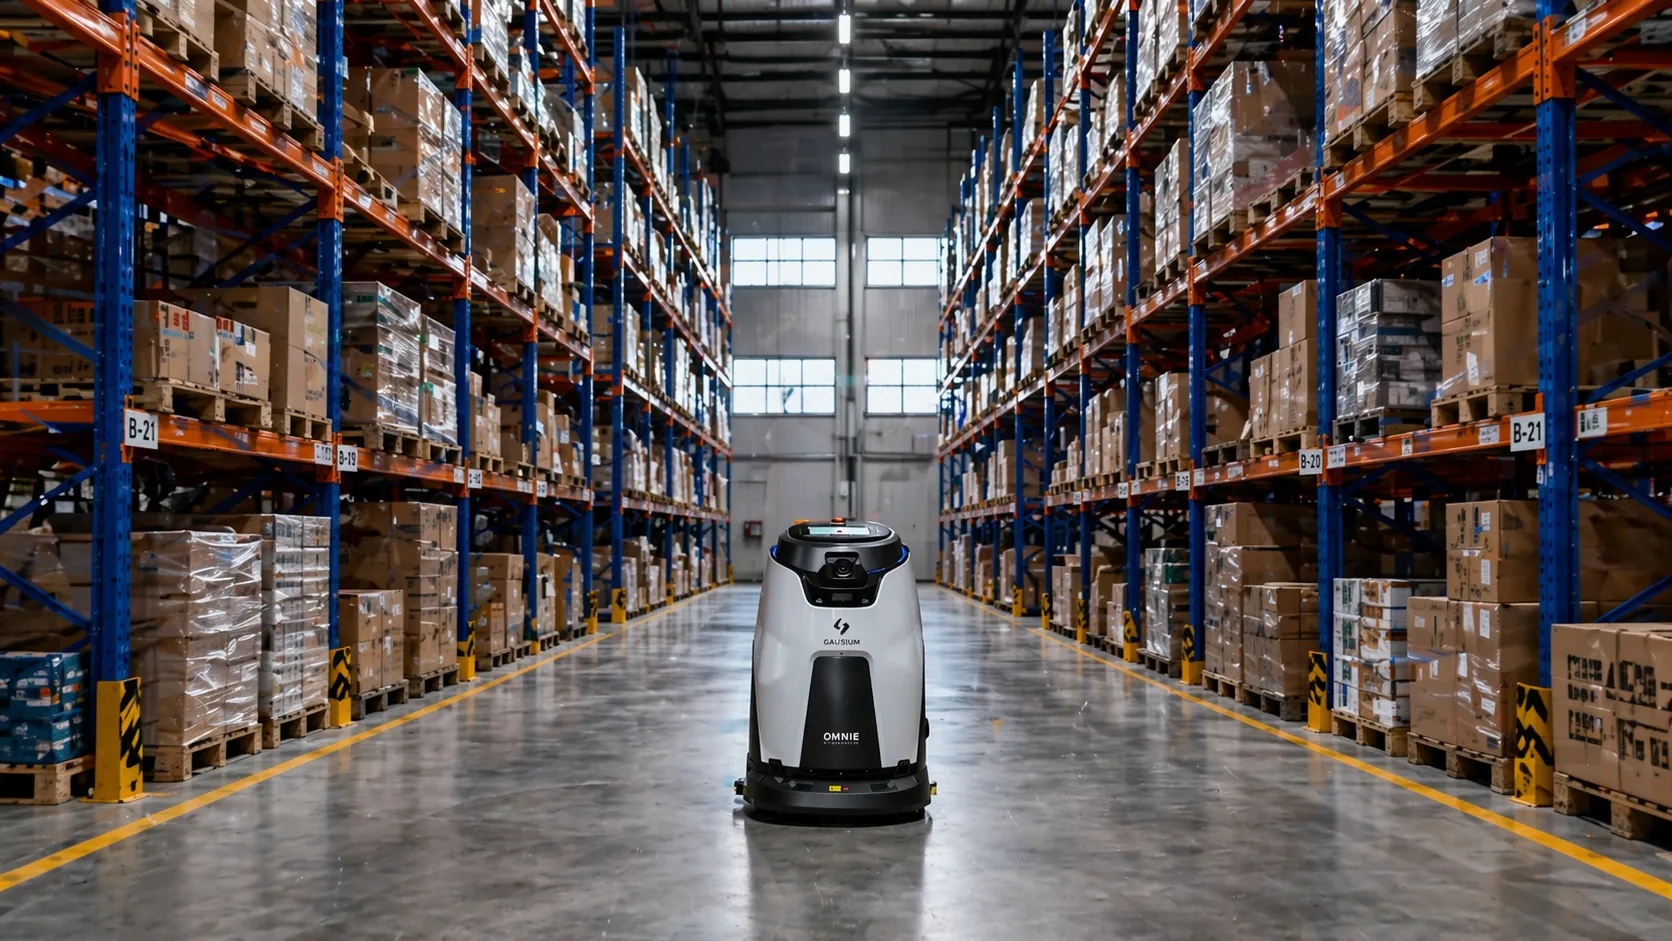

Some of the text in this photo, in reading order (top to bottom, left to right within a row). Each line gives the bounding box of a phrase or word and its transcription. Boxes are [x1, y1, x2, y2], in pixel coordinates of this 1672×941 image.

[129, 417, 155, 441] B-21
[1513, 421, 1541, 443] B-21
[339, 450, 356, 466] B-19
[1301, 454, 1320, 468] B-20
[823, 732, 860, 741] OMNIE
